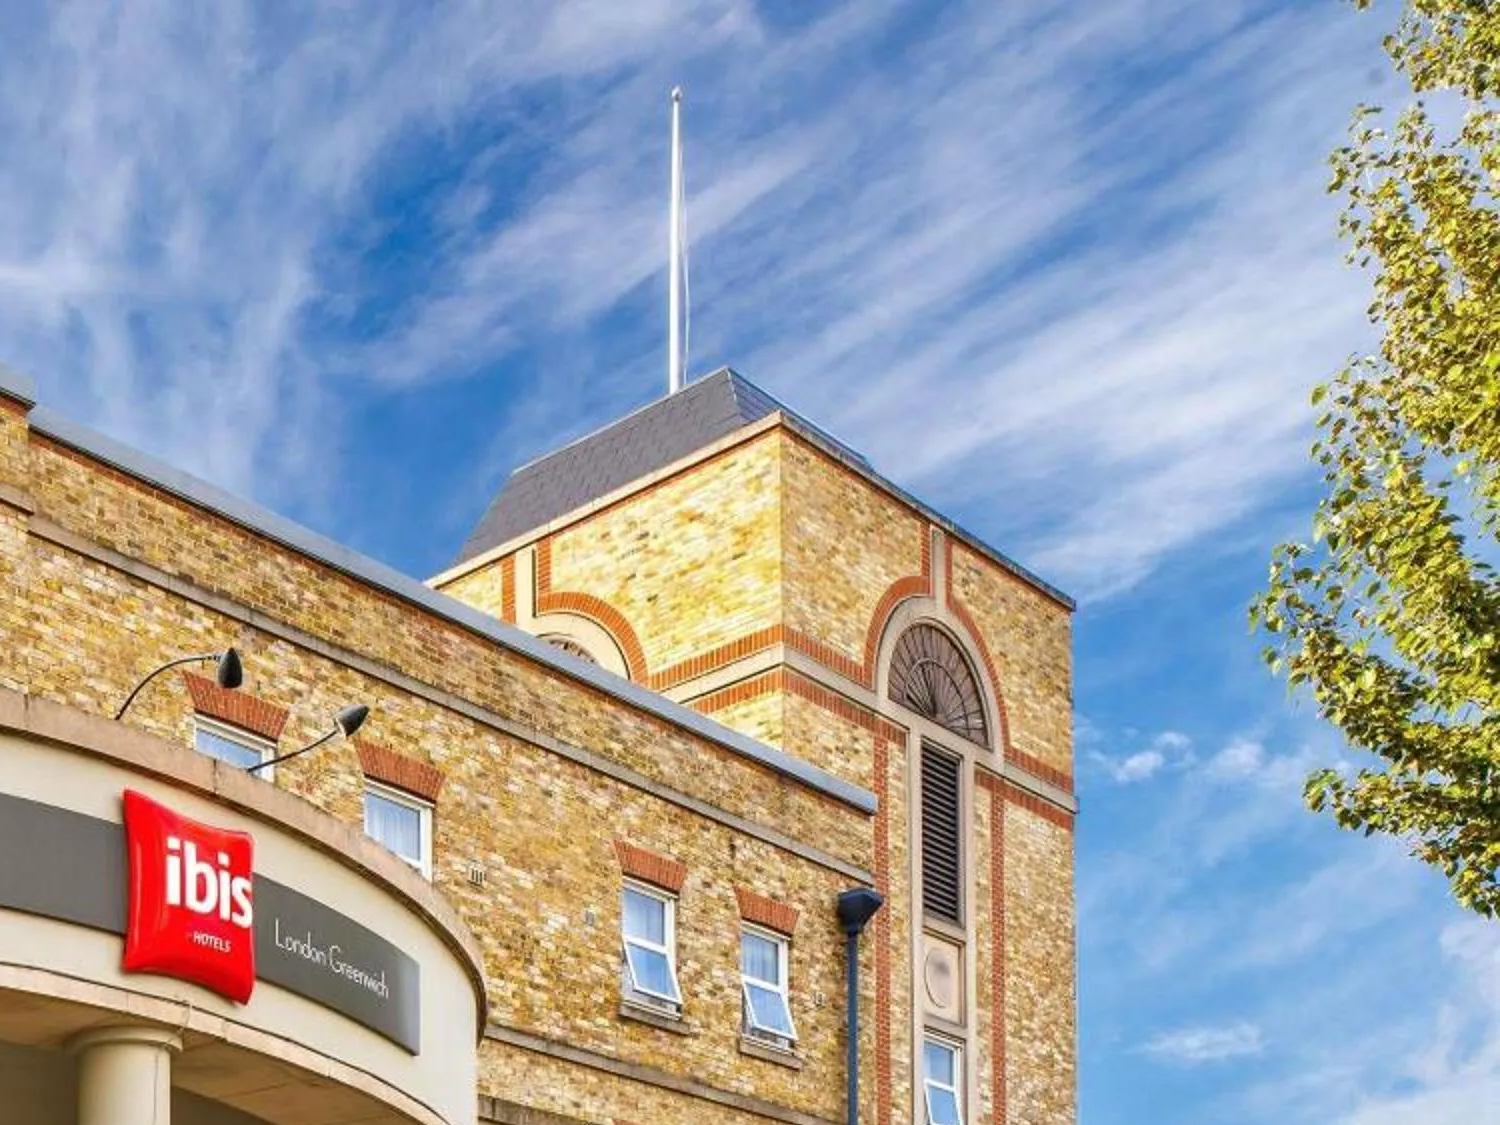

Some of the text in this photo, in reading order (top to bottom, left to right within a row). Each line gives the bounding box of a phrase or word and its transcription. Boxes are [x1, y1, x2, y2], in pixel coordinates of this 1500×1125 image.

[165, 837, 252, 928] ibis
[193, 930, 232, 953] HOTELS
[275, 917, 389, 999] London Greenwich
